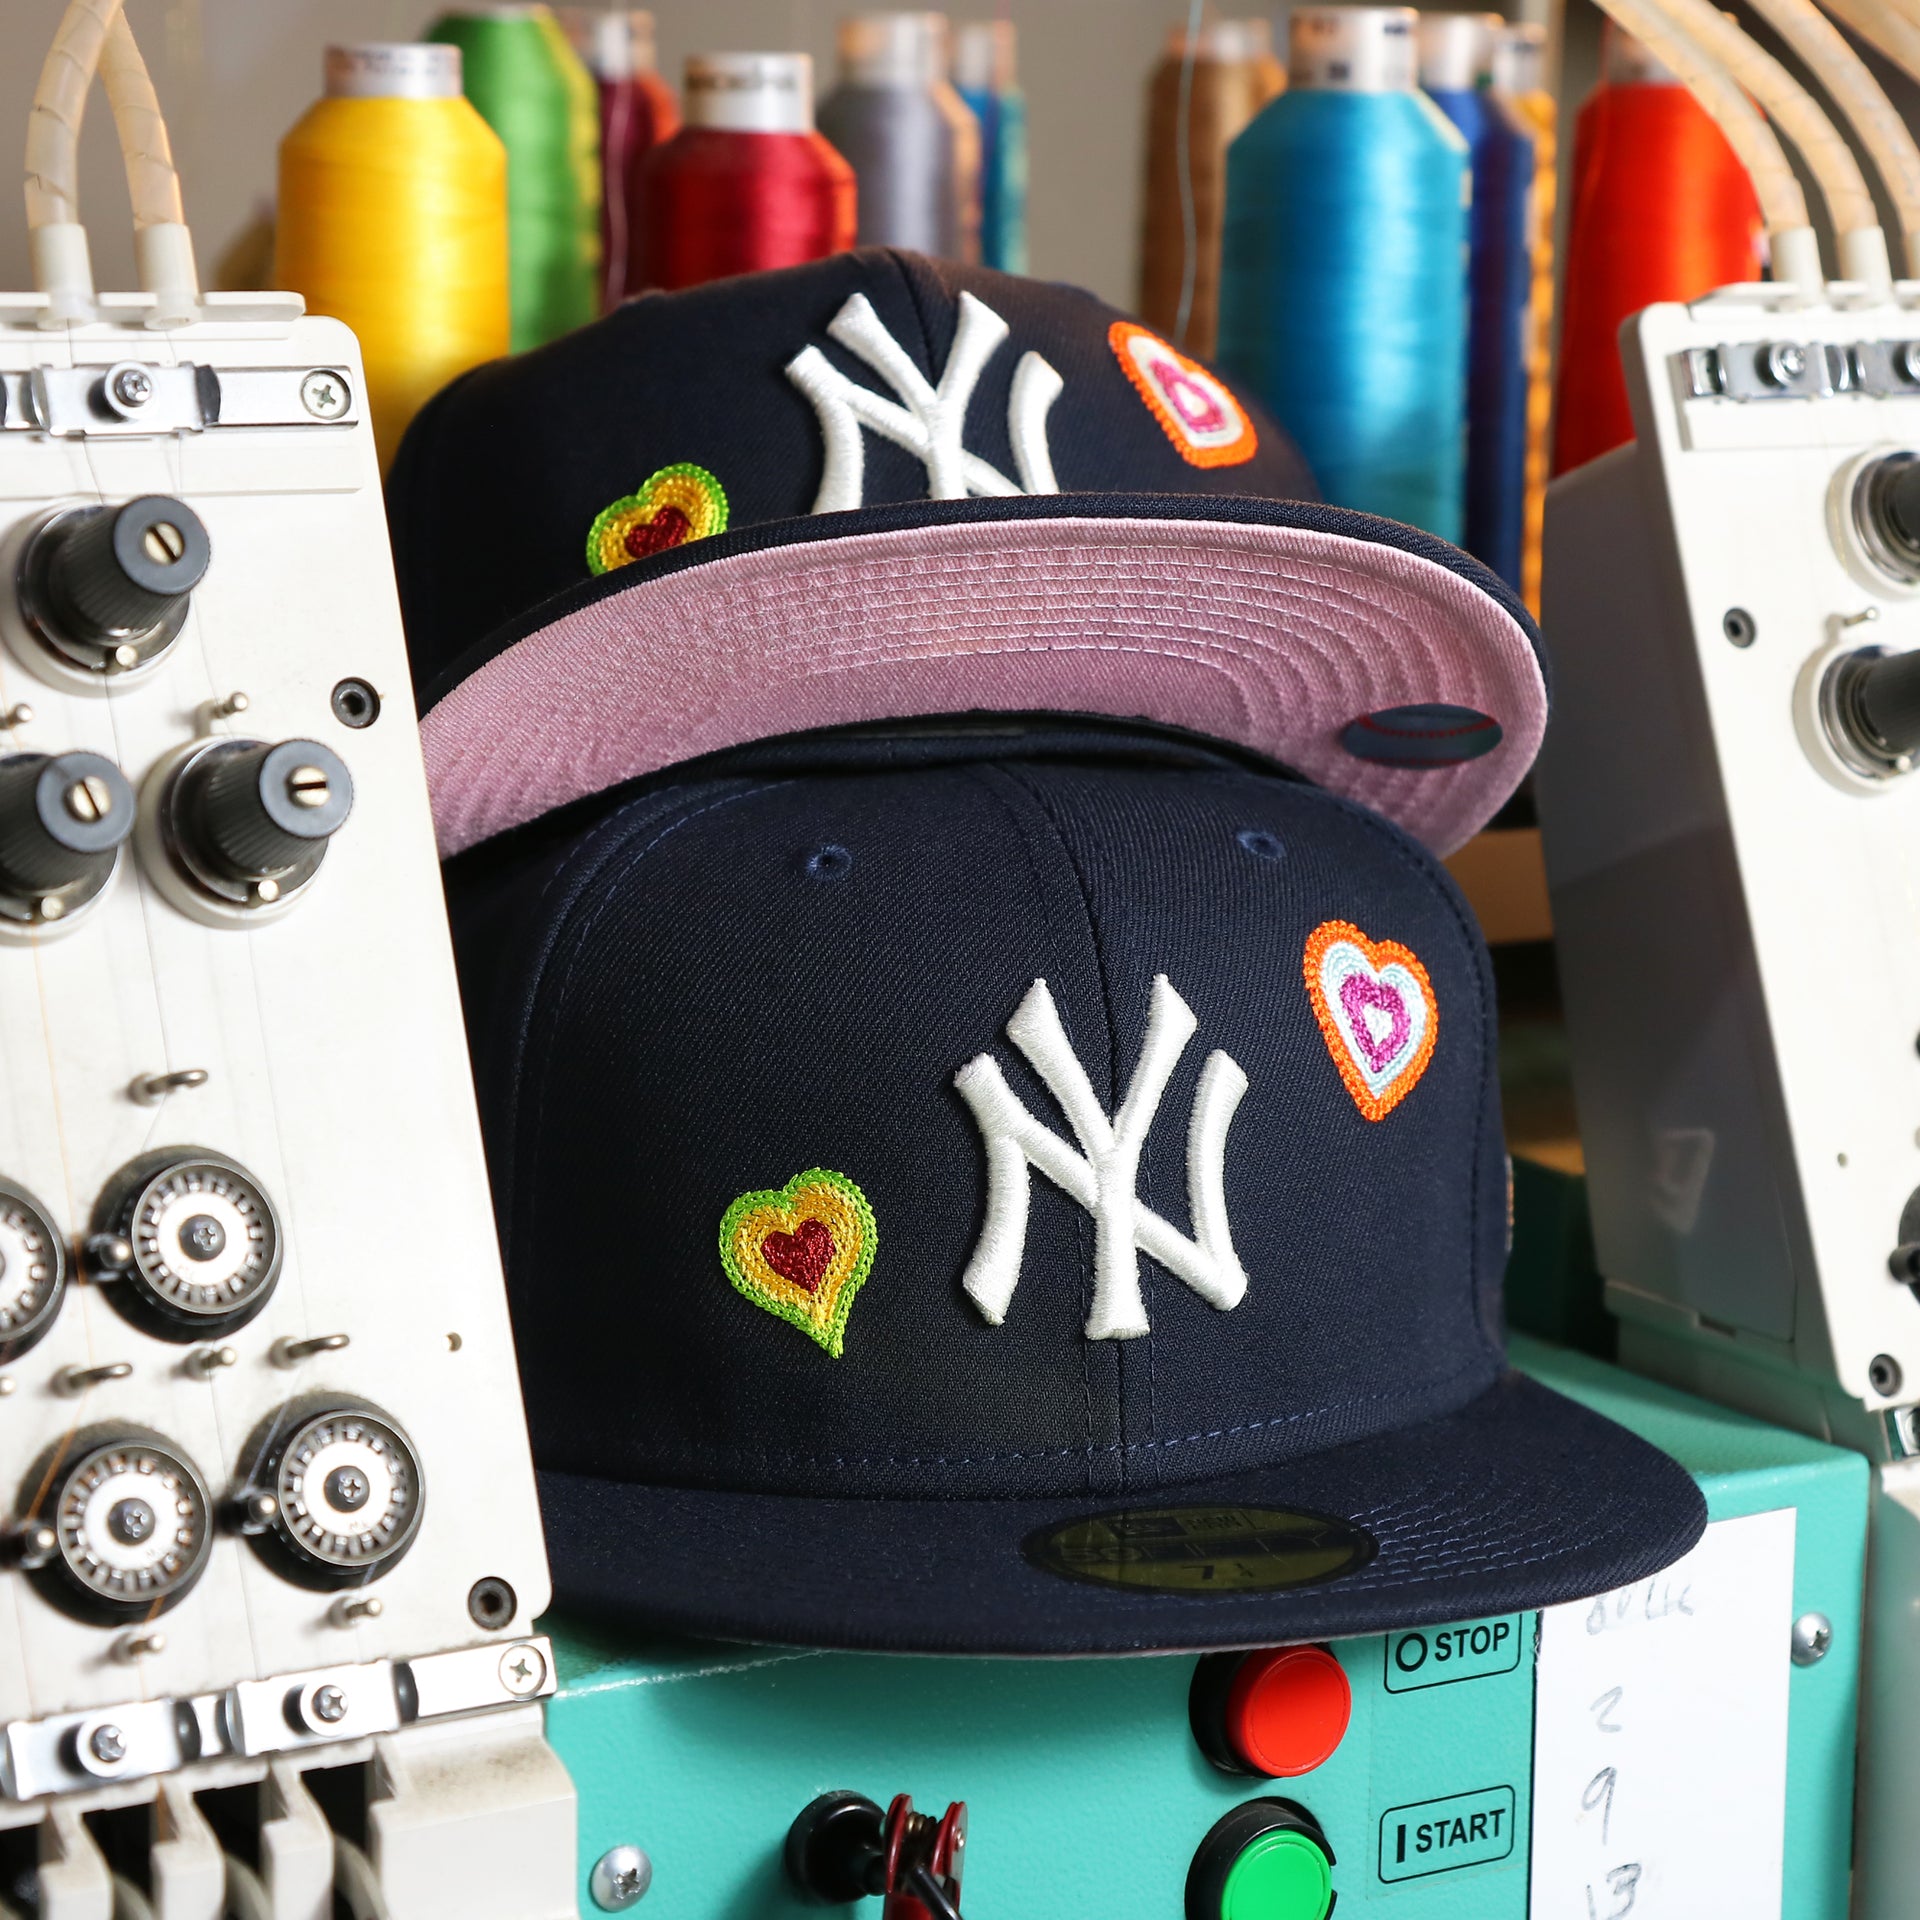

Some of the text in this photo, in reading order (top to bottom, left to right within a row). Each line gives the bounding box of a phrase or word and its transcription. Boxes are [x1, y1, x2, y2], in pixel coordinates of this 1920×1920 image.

[954, 973, 1249, 1341] NY
[1434, 1622, 1510, 1662] STOP
[1589, 1685, 1623, 1733] 2
[1581, 1766, 1618, 1846] 9
[1415, 1808, 1506, 1854] START
